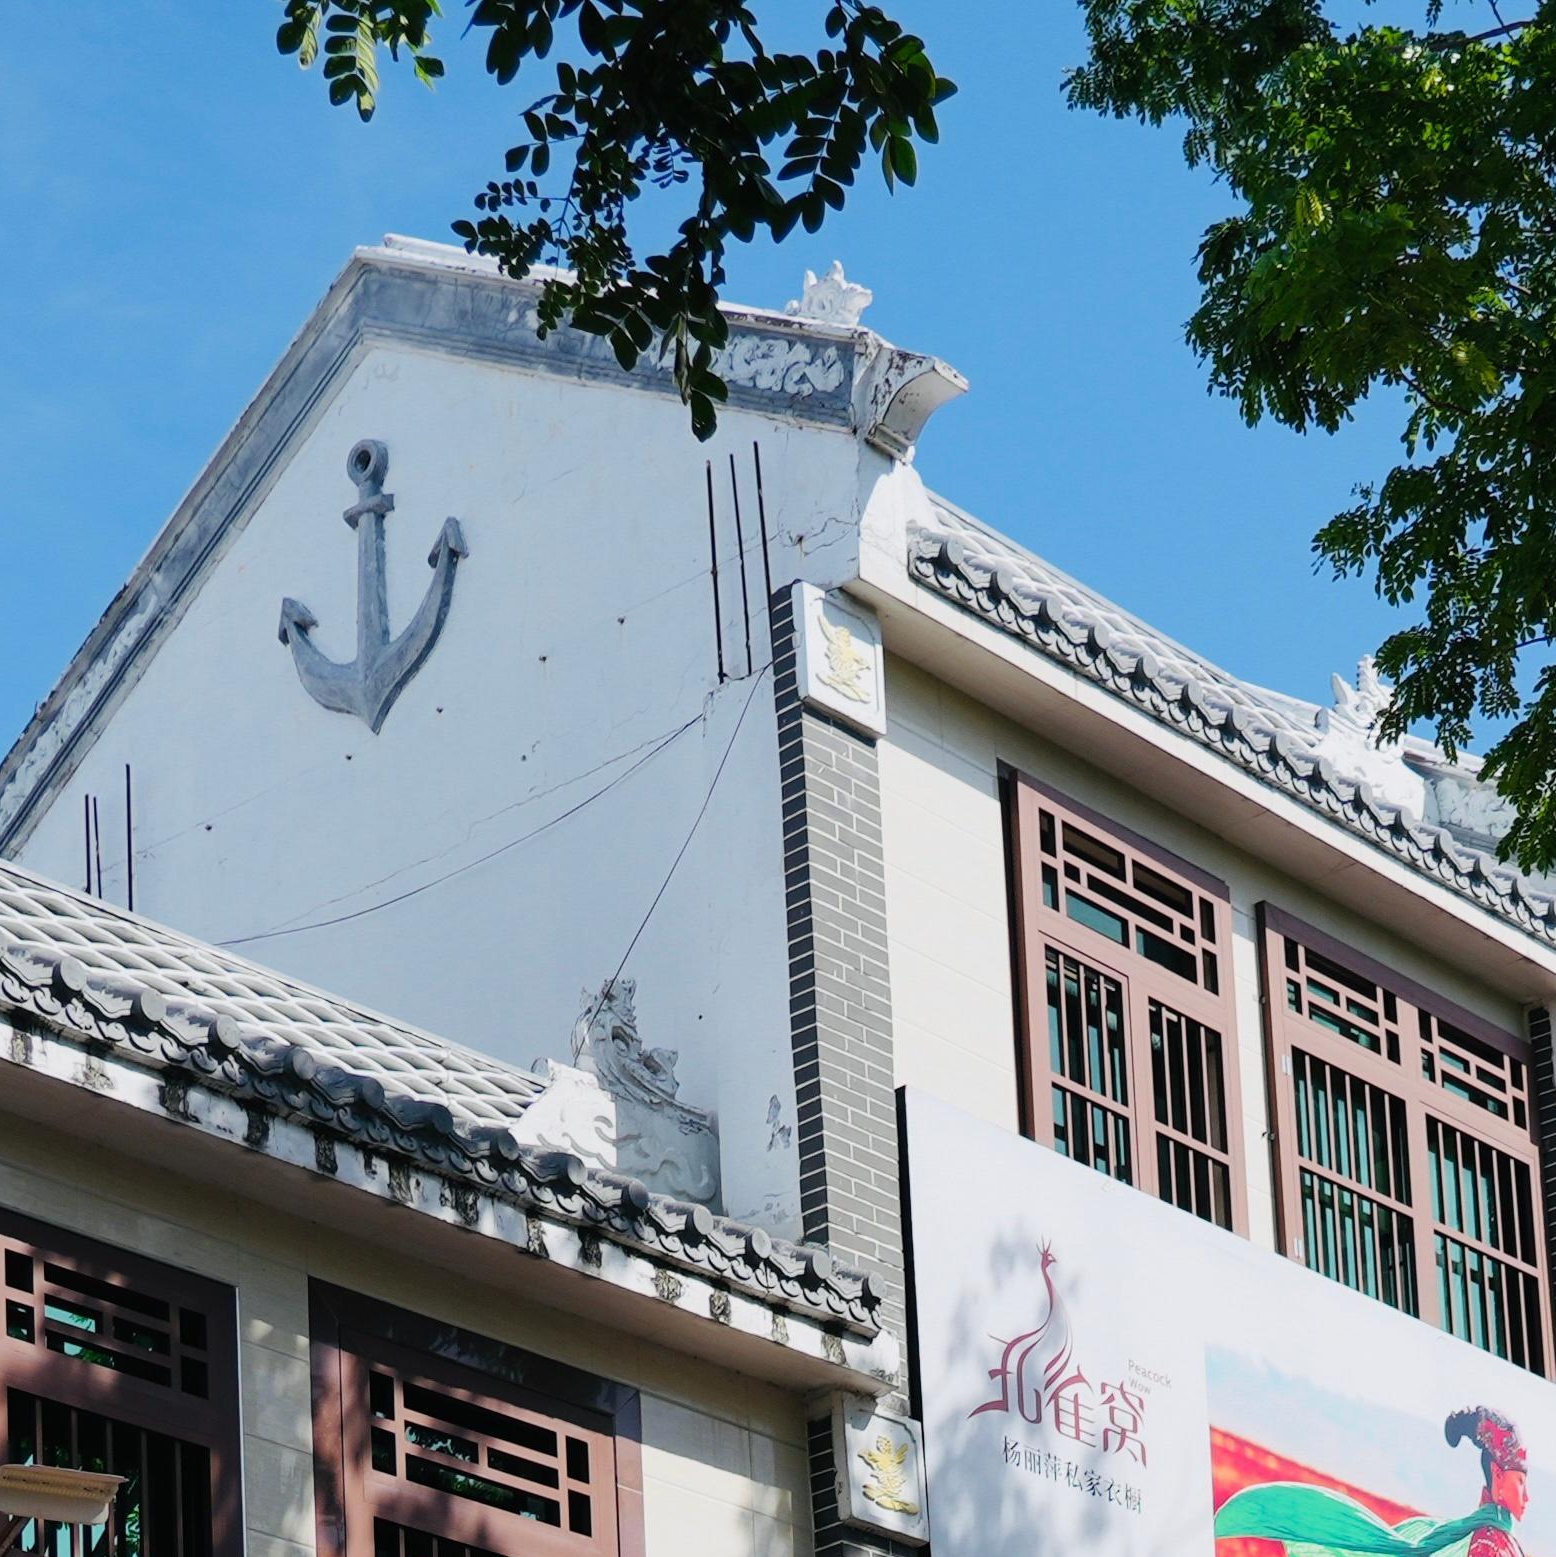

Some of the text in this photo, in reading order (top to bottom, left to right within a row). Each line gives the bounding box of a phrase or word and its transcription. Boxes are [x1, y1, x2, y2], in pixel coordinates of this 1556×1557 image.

[1128, 1359, 1173, 1387] Peacock
[1129, 1377, 1152, 1396] Wow
[1002, 1435, 1143, 1514] 杨丽萍私家衣橱
